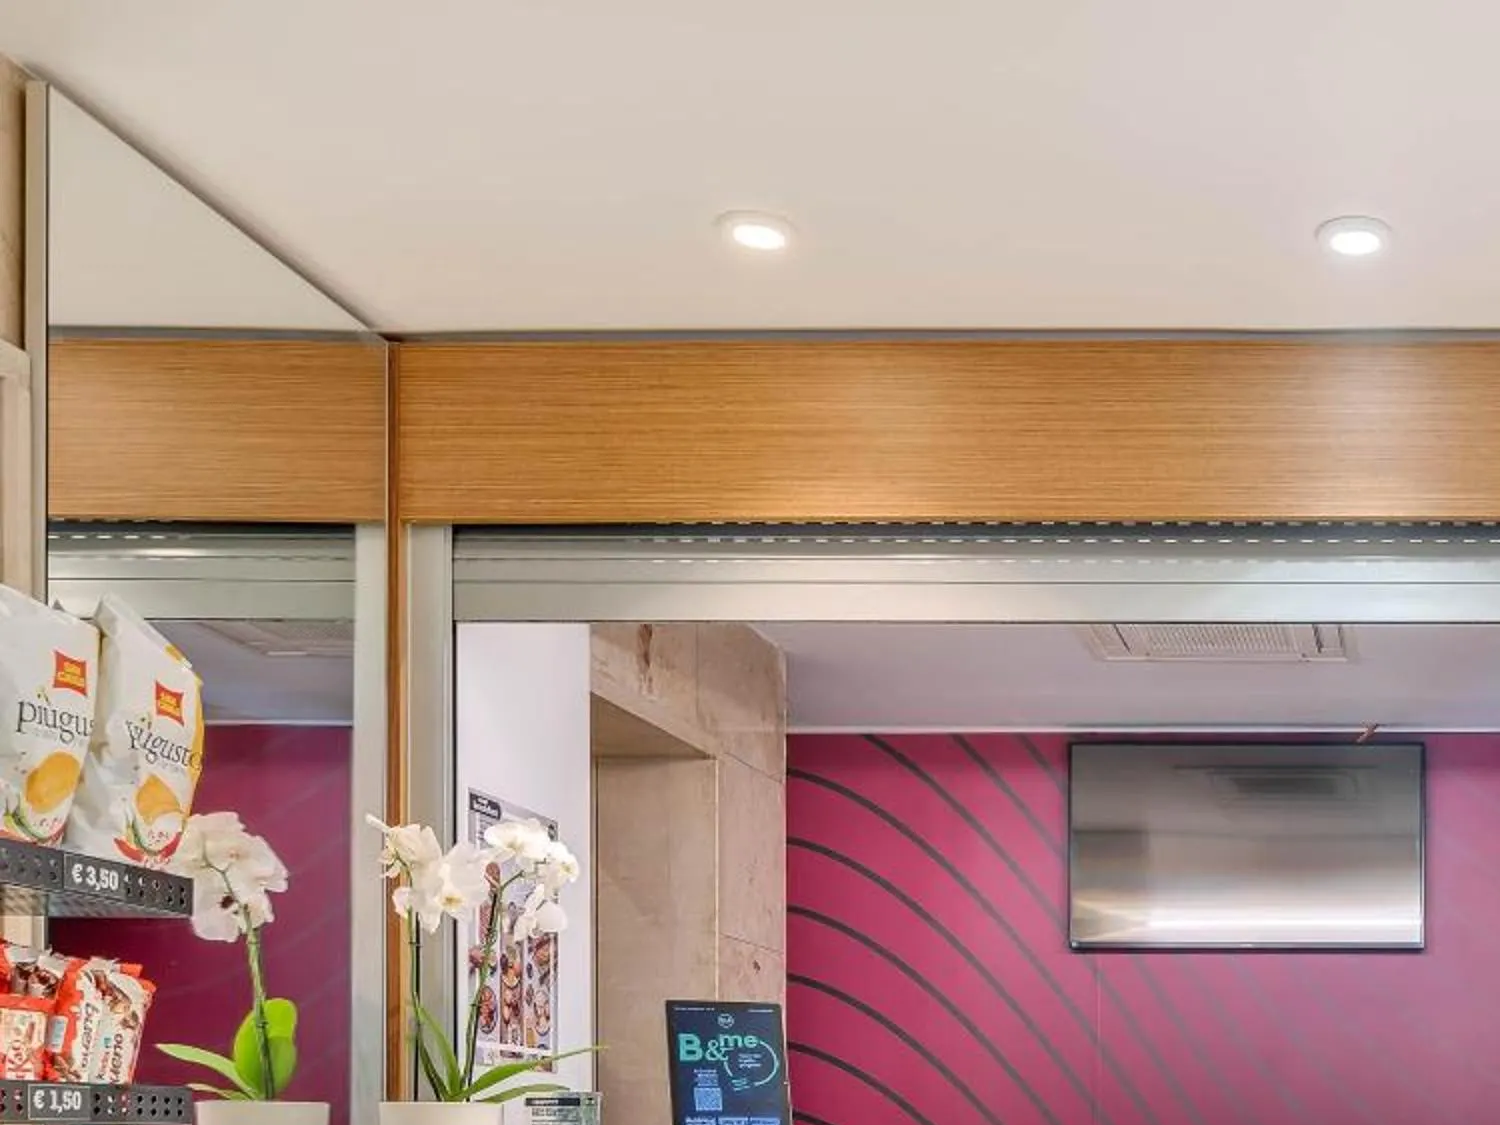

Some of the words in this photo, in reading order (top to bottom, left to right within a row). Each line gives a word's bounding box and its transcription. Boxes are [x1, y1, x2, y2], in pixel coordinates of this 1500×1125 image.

[71, 863, 84, 884] €
[85, 865, 120, 891] 3,50
[677, 1033, 758, 1063] B&me
[33, 1089, 45, 1110] €
[49, 1090, 82, 1113] 1,50
